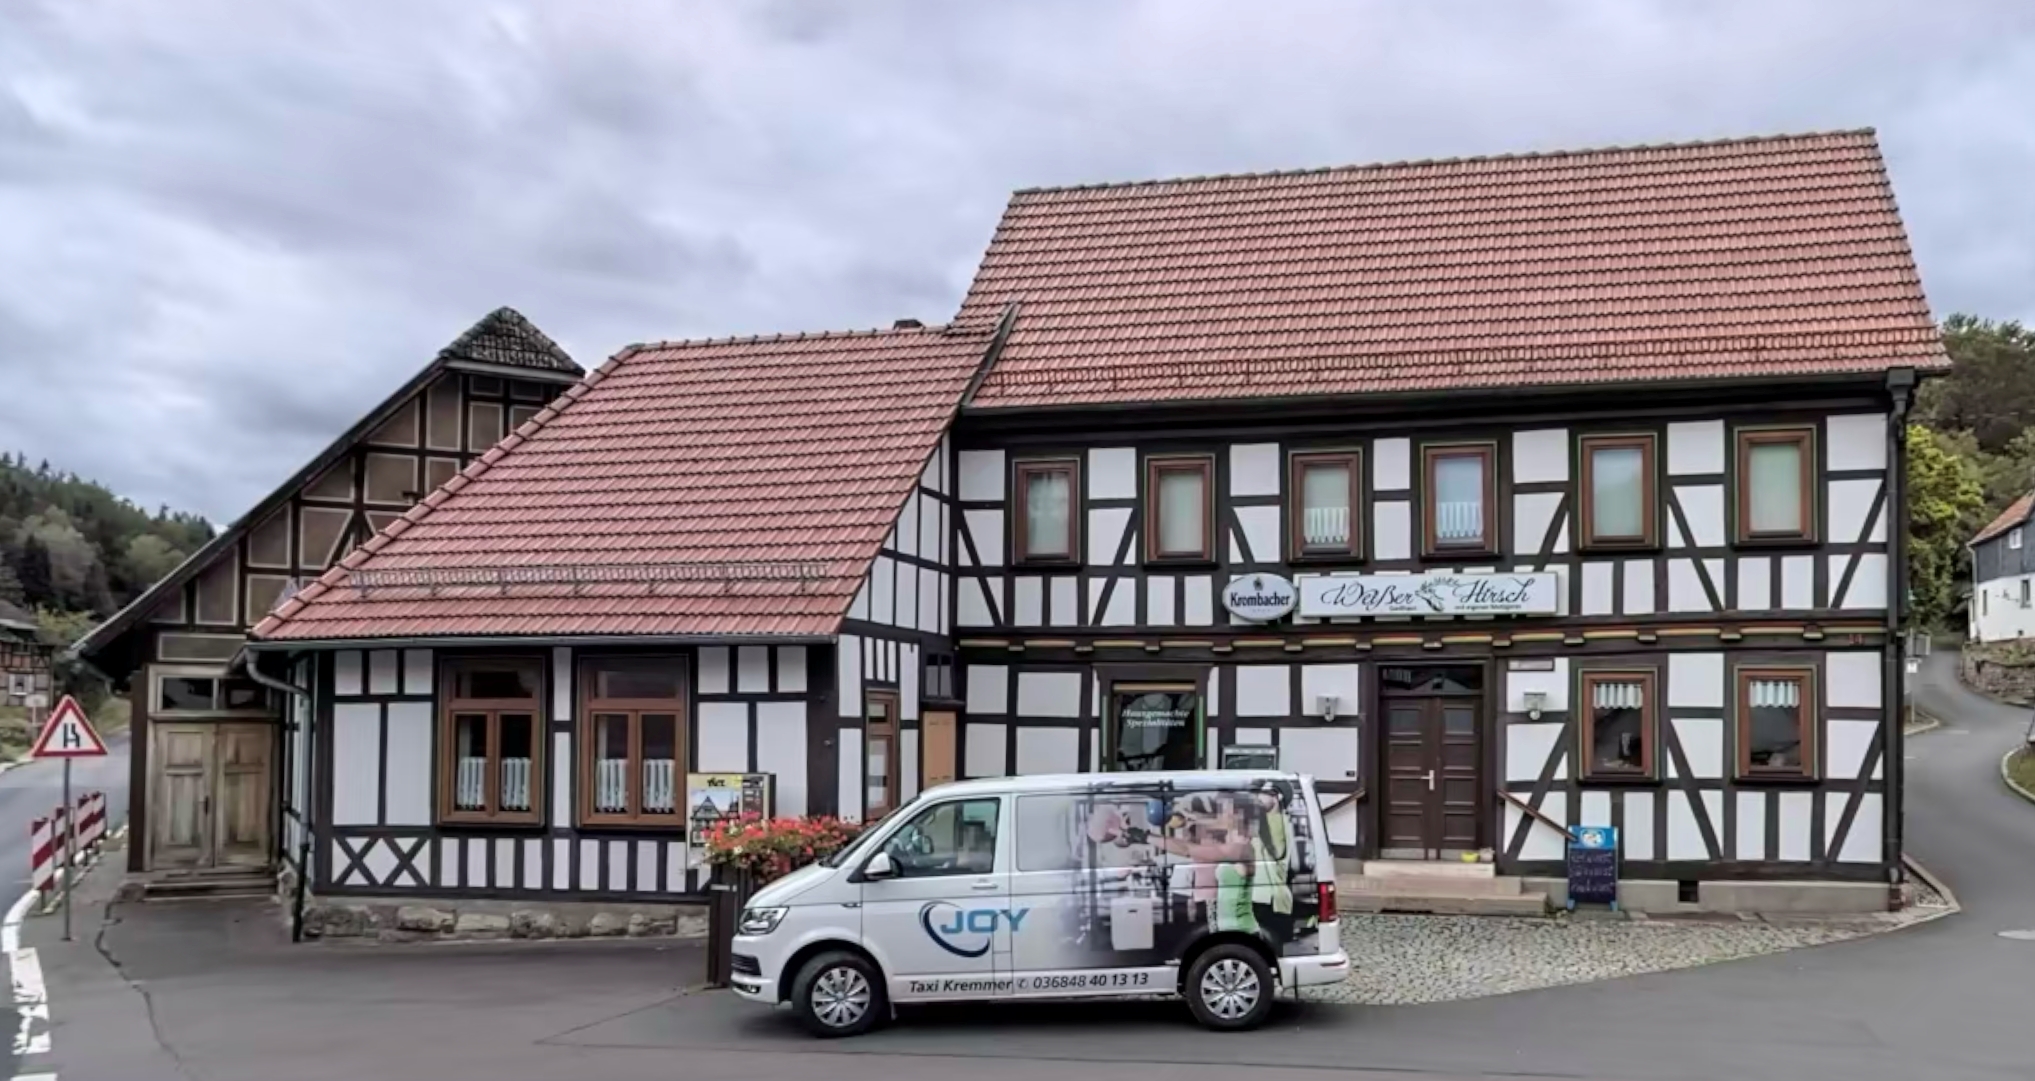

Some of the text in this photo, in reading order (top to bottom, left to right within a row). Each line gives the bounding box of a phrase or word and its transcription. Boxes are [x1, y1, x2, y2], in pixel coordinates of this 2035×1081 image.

[1230, 590, 1290, 607] Krombacher
[1452, 577, 1536, 603] Hirsch
[1121, 709, 1190, 719] Hausgemachte
[940, 908, 1030, 934] JOY
[909, 972, 1149, 993] Taxi Kremmer 036848 40 13 13
